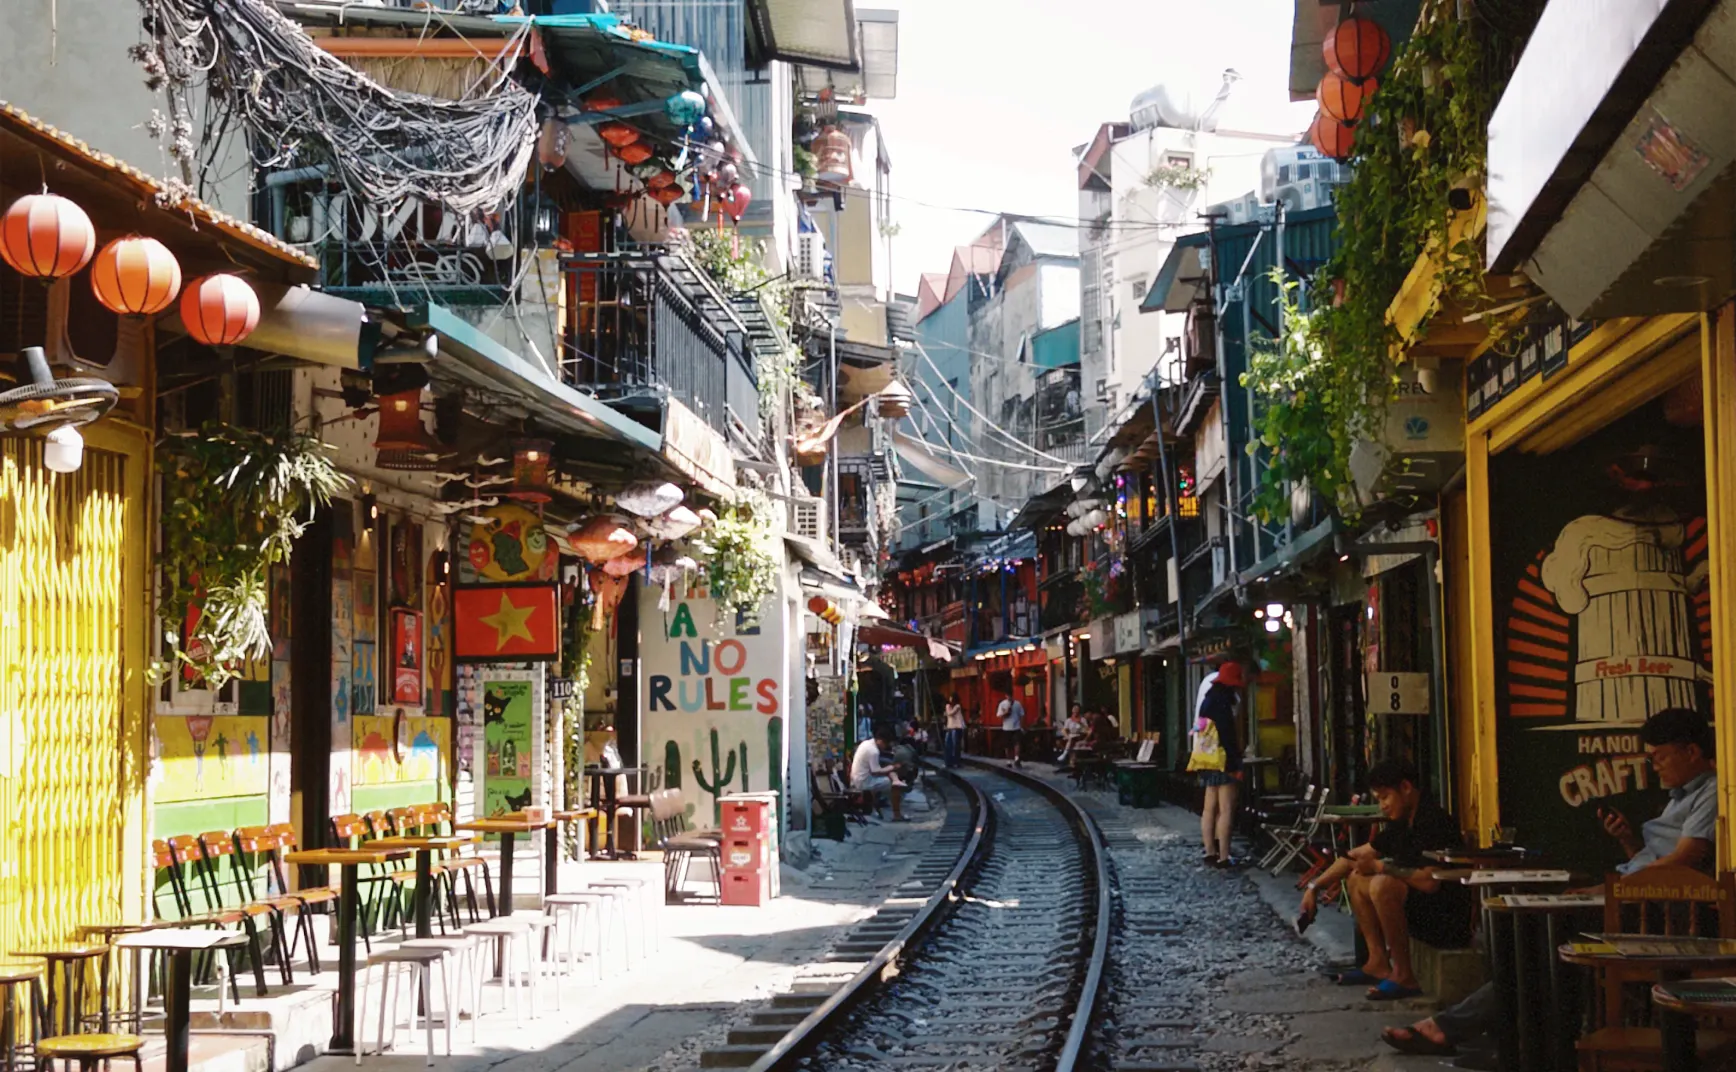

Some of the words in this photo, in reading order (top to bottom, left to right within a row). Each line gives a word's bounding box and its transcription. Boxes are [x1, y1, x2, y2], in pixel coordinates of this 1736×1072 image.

[669, 602, 761, 638] AE
[680, 638, 747, 676] NO
[1594, 658, 1632, 678] Fresh
[1637, 657, 1674, 674] Beer
[554, 682, 572, 697] 110
[649, 674, 779, 715] RULES
[1578, 734, 1639, 753] HANOI
[1559, 754, 1650, 808] CRAFT
[1613, 883, 1680, 899] Eisenbahn
[1683, 884, 1727, 900] Kaffee
